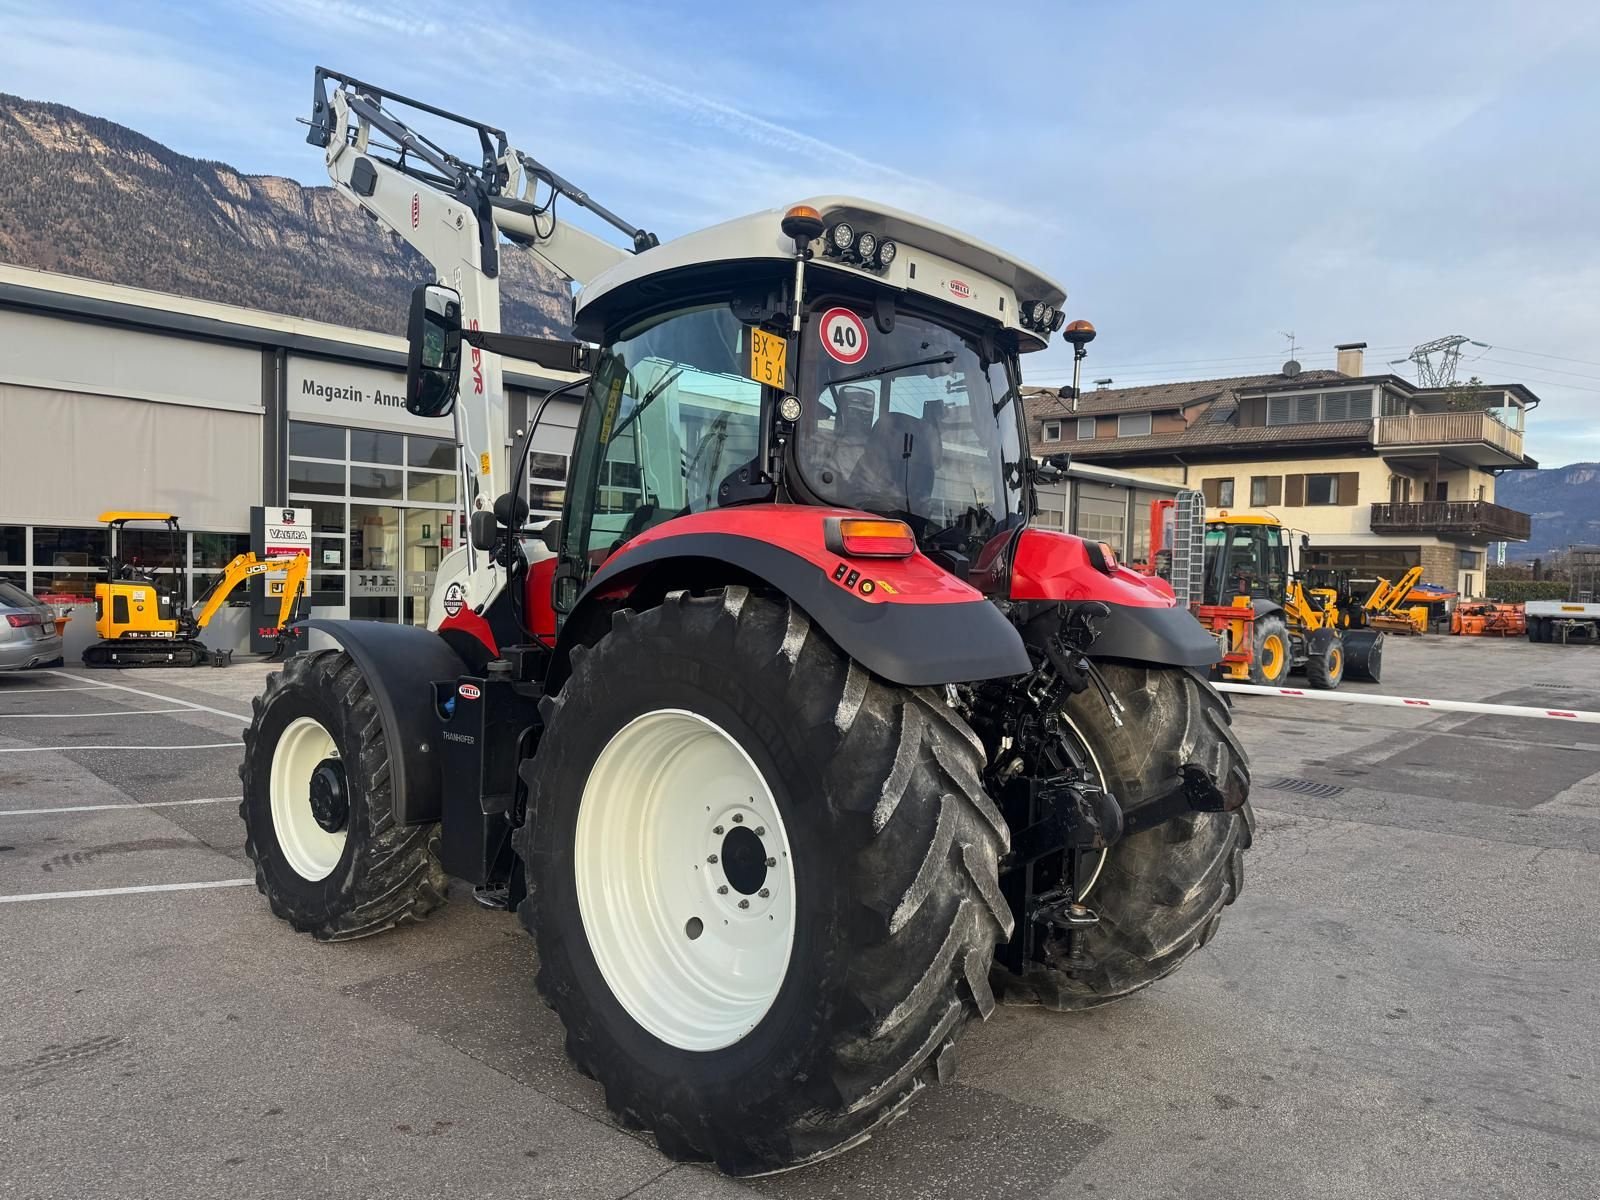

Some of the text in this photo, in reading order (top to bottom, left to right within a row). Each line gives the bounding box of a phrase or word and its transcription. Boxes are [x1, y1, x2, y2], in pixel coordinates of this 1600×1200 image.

[753, 332, 785, 362] BX 7
[833, 325, 857, 348] 40
[469, 318, 483, 396] SEYR
[302, 379, 363, 402] Magazin
[374, 389, 407, 408] Anna
[246, 564, 268, 574] JCB
